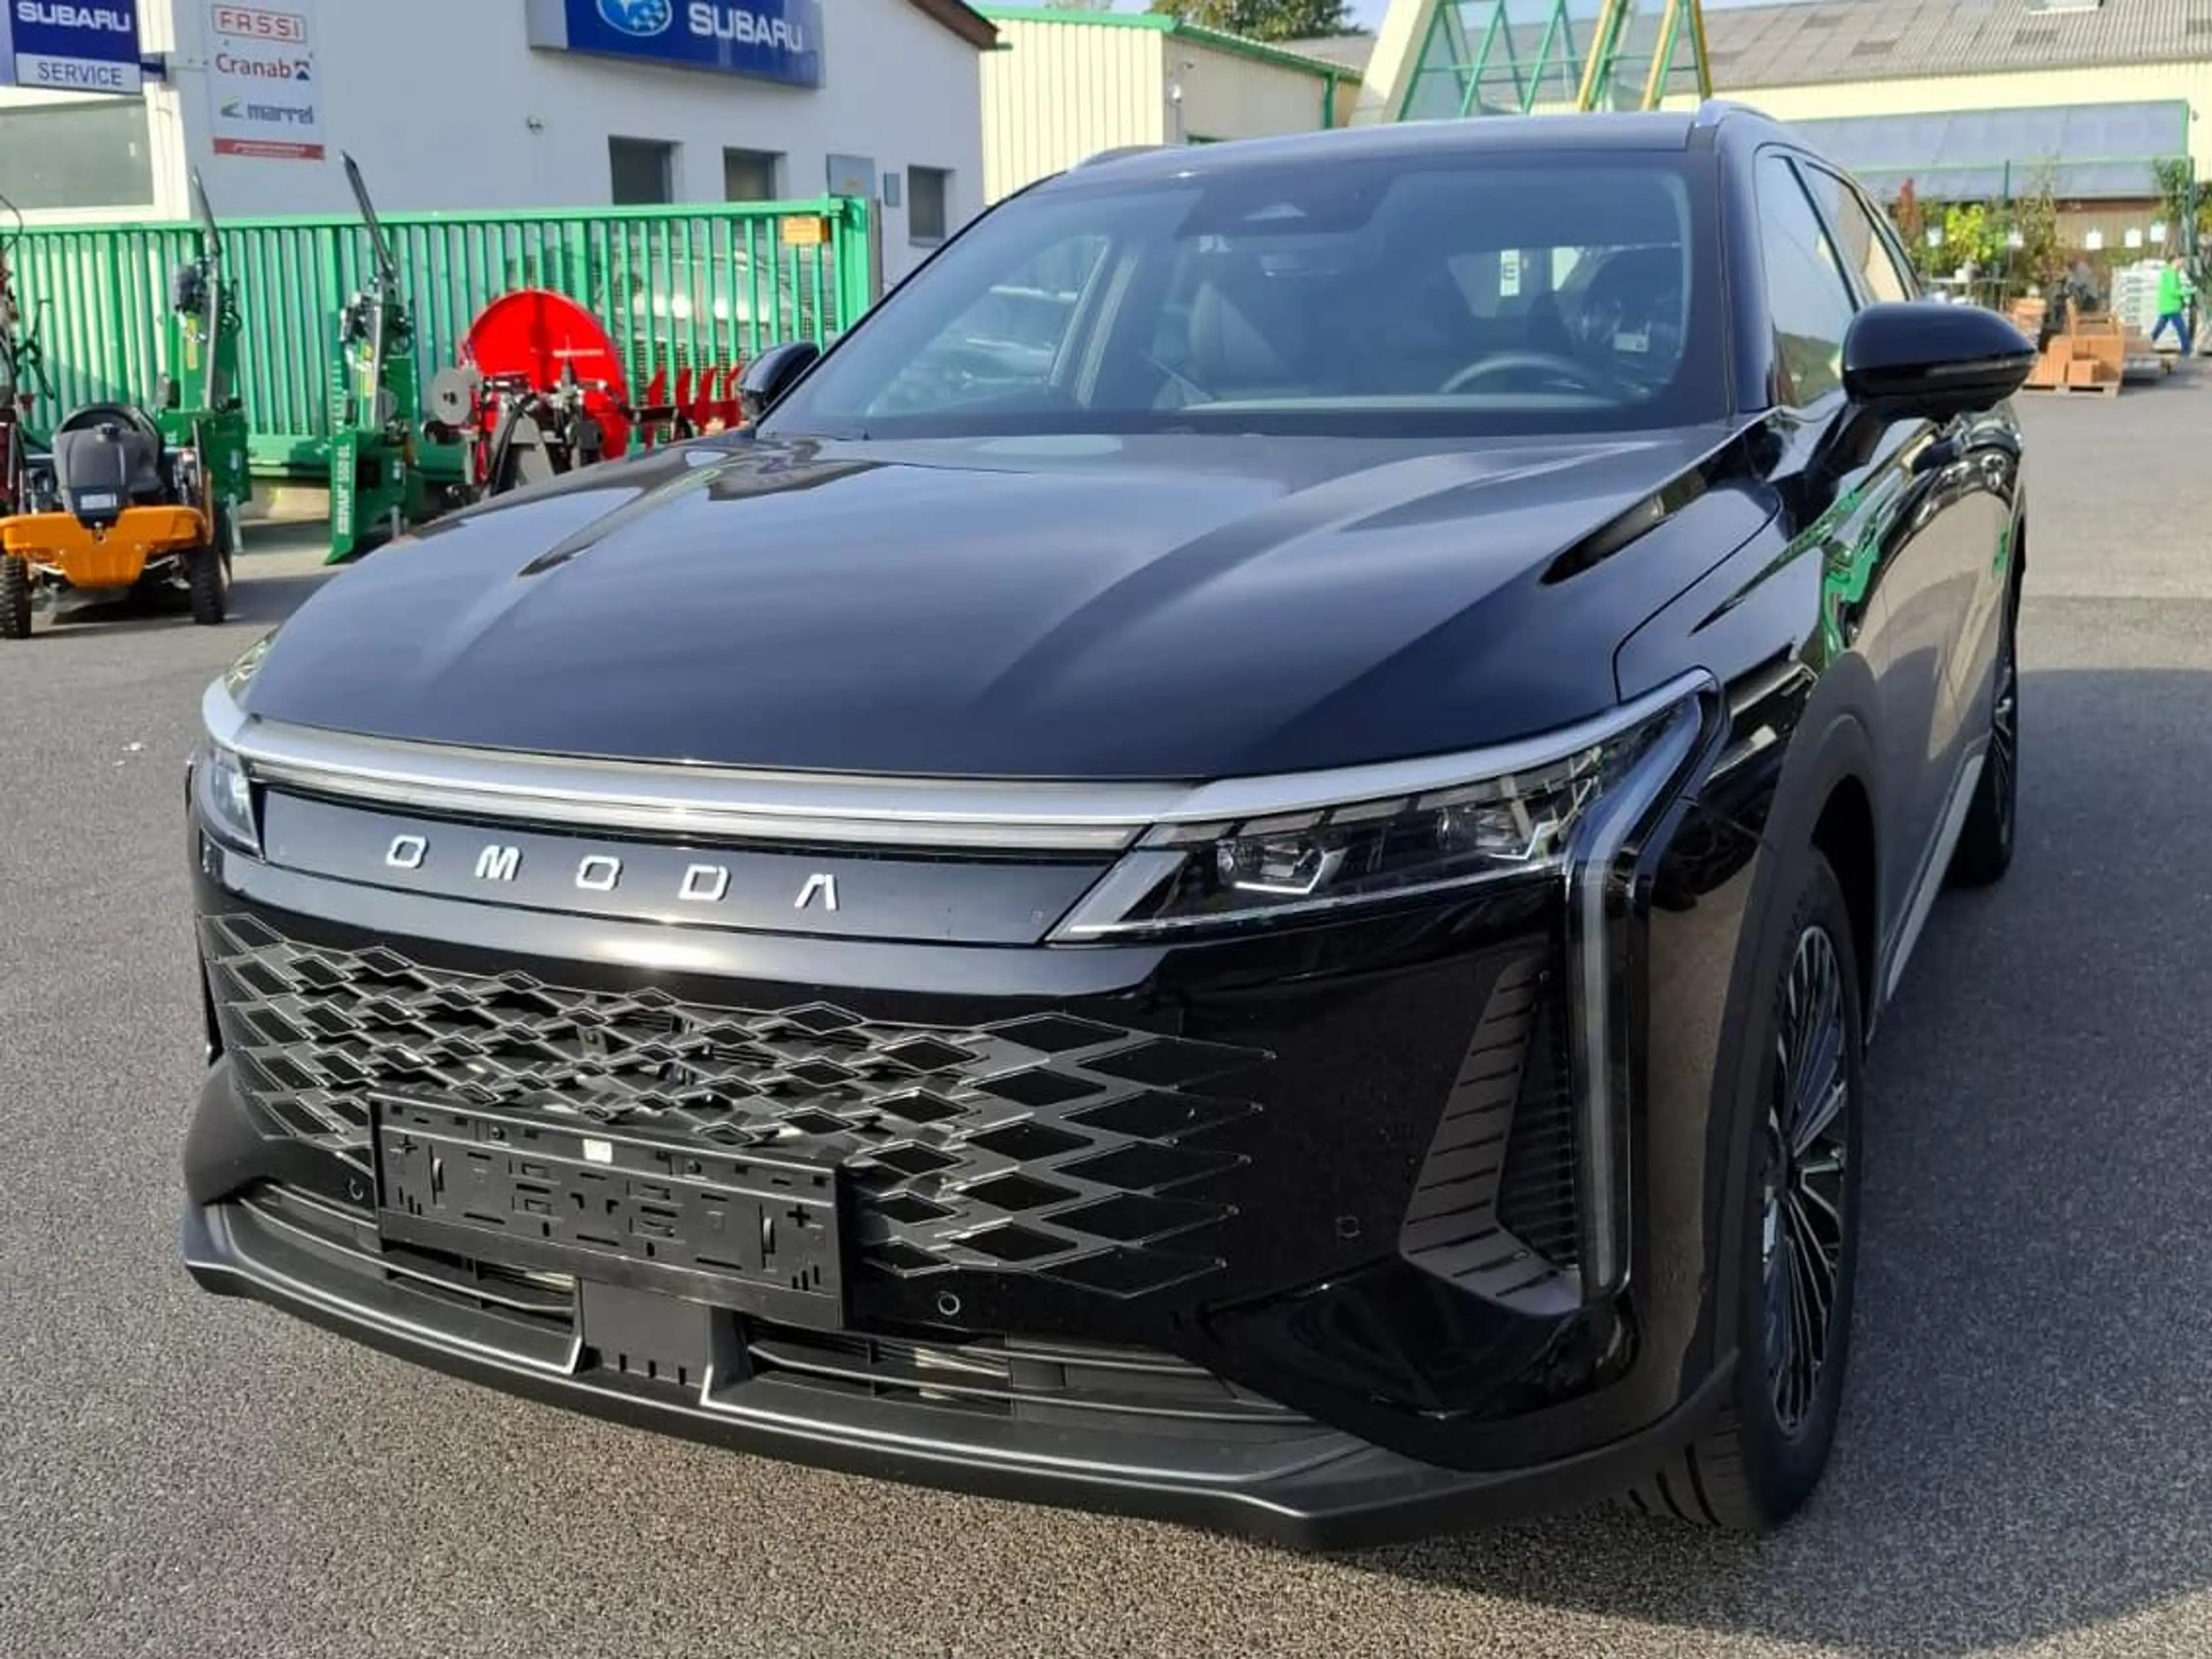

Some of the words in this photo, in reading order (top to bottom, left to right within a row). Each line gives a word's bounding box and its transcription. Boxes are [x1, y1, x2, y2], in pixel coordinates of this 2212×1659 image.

[17, 1, 131, 32] SUBARU
[219, 12, 299, 39] FASSI
[688, 2, 803, 52] SUBARU
[37, 62, 123, 86] SERVICE
[215, 52, 292, 79] Cranab
[247, 103, 315, 124] marrel
[385, 835, 841, 911] OMODA
